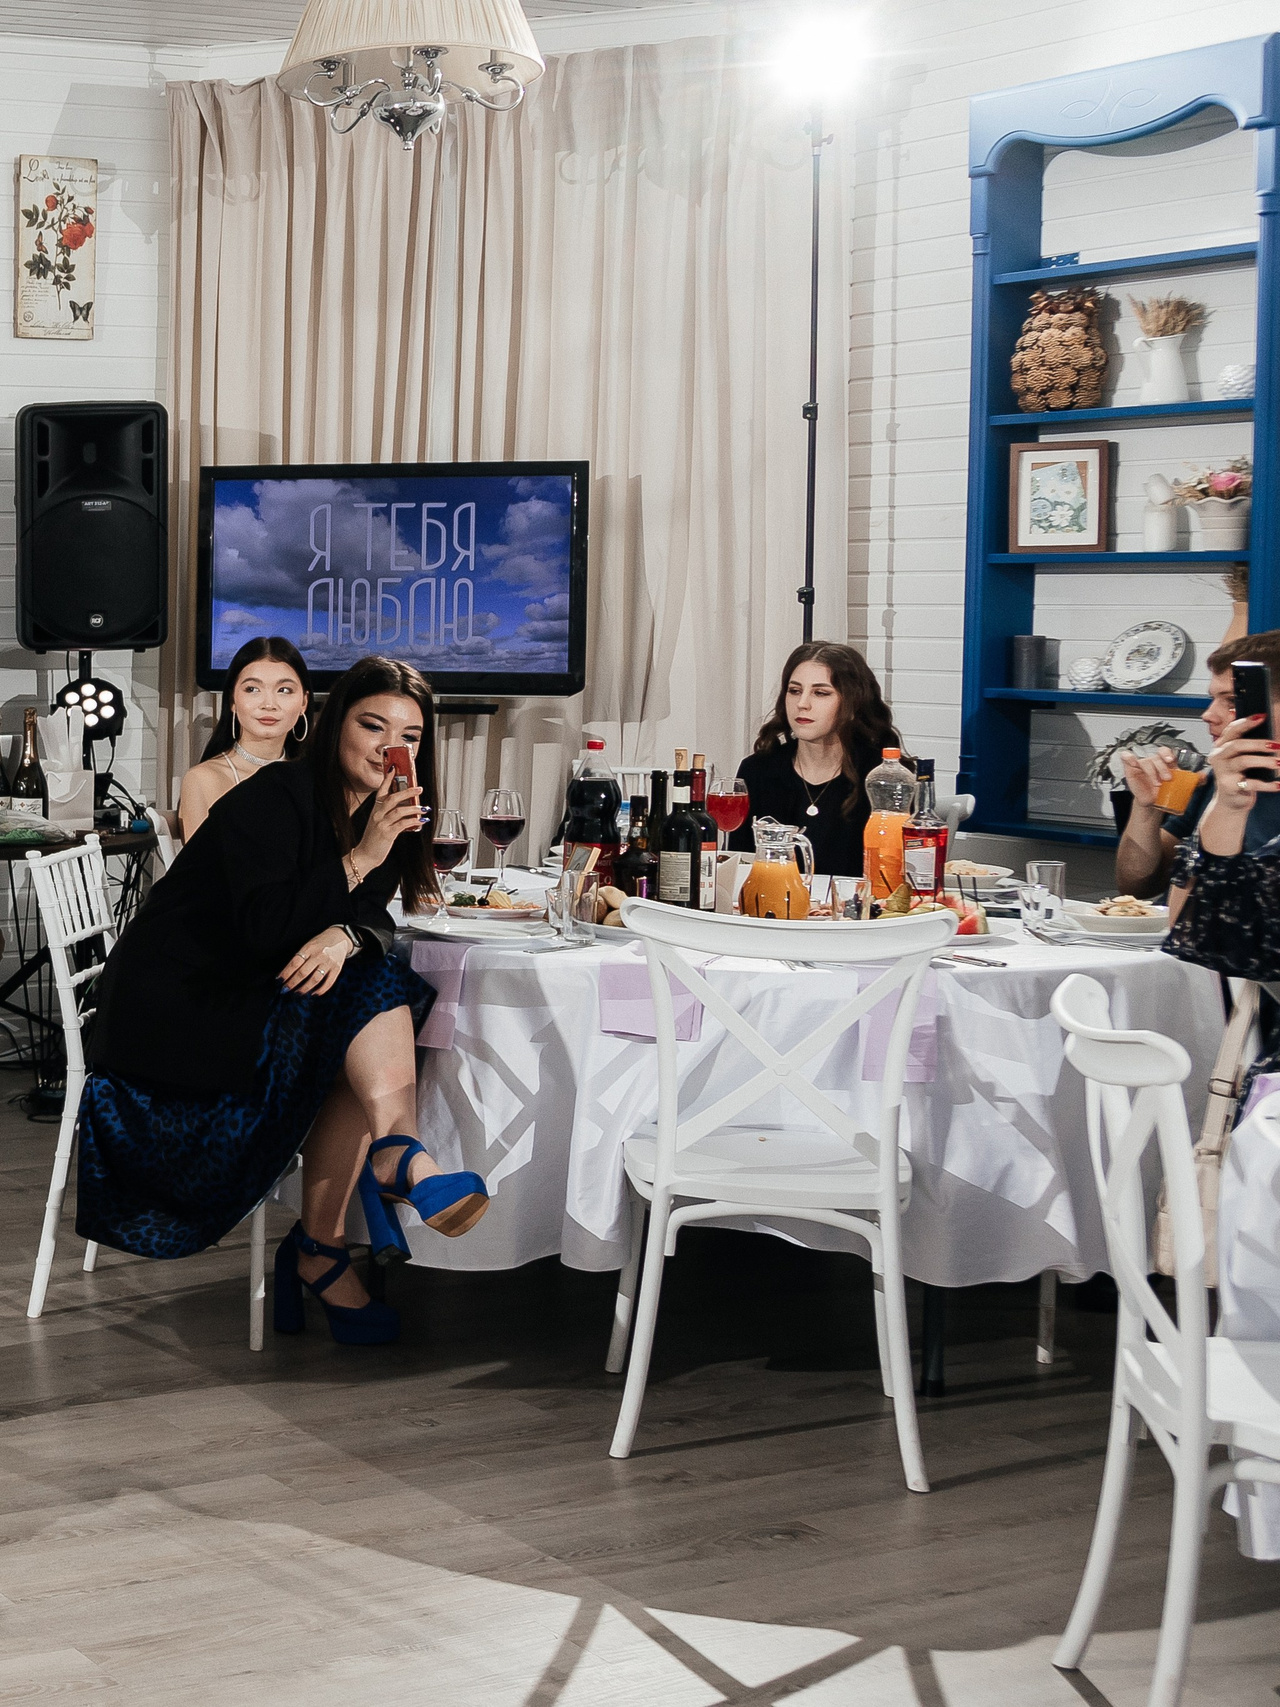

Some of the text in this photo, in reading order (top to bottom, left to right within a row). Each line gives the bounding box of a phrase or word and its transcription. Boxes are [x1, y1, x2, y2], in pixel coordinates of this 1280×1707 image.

[307, 502, 476, 572] Я ТЕБЯ
[306, 577, 474, 647] ЛЮБЛЮ
